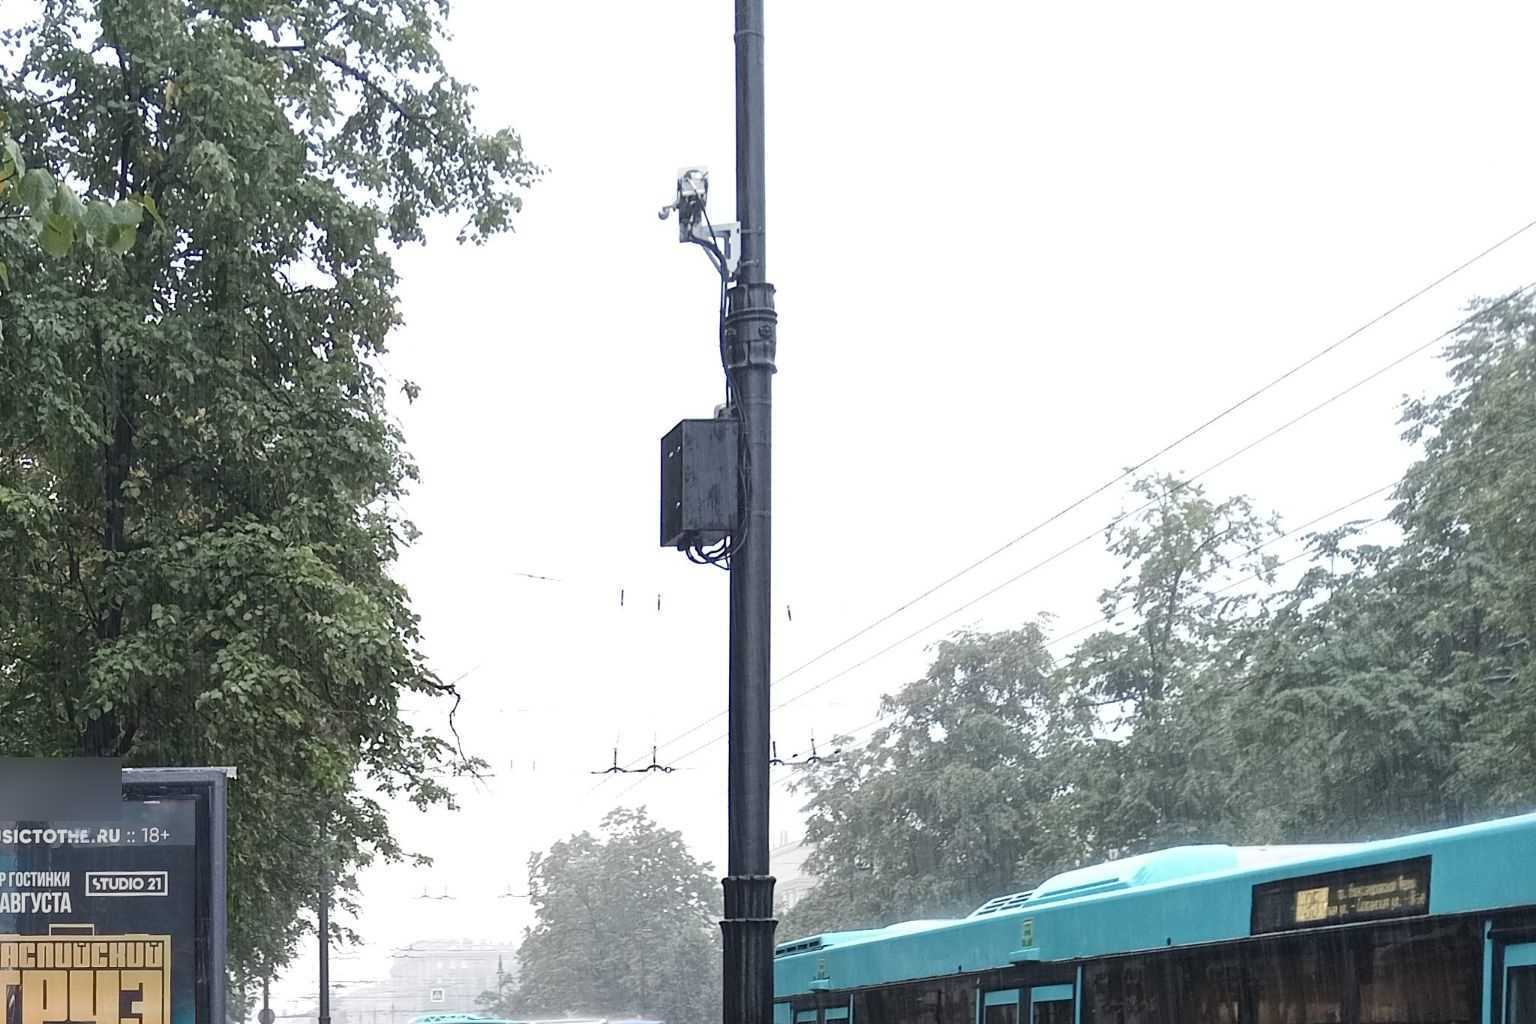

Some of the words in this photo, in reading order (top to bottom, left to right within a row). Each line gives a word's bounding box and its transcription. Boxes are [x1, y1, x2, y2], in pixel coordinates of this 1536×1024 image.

[141, 827, 170, 843] 18+
[9, 871, 71, 888] ГОСТИНКИ
[92, 877, 145, 891] STUDIO
[148, 877, 162, 891] 21
[0, 892, 72, 914] АВГУСТА
